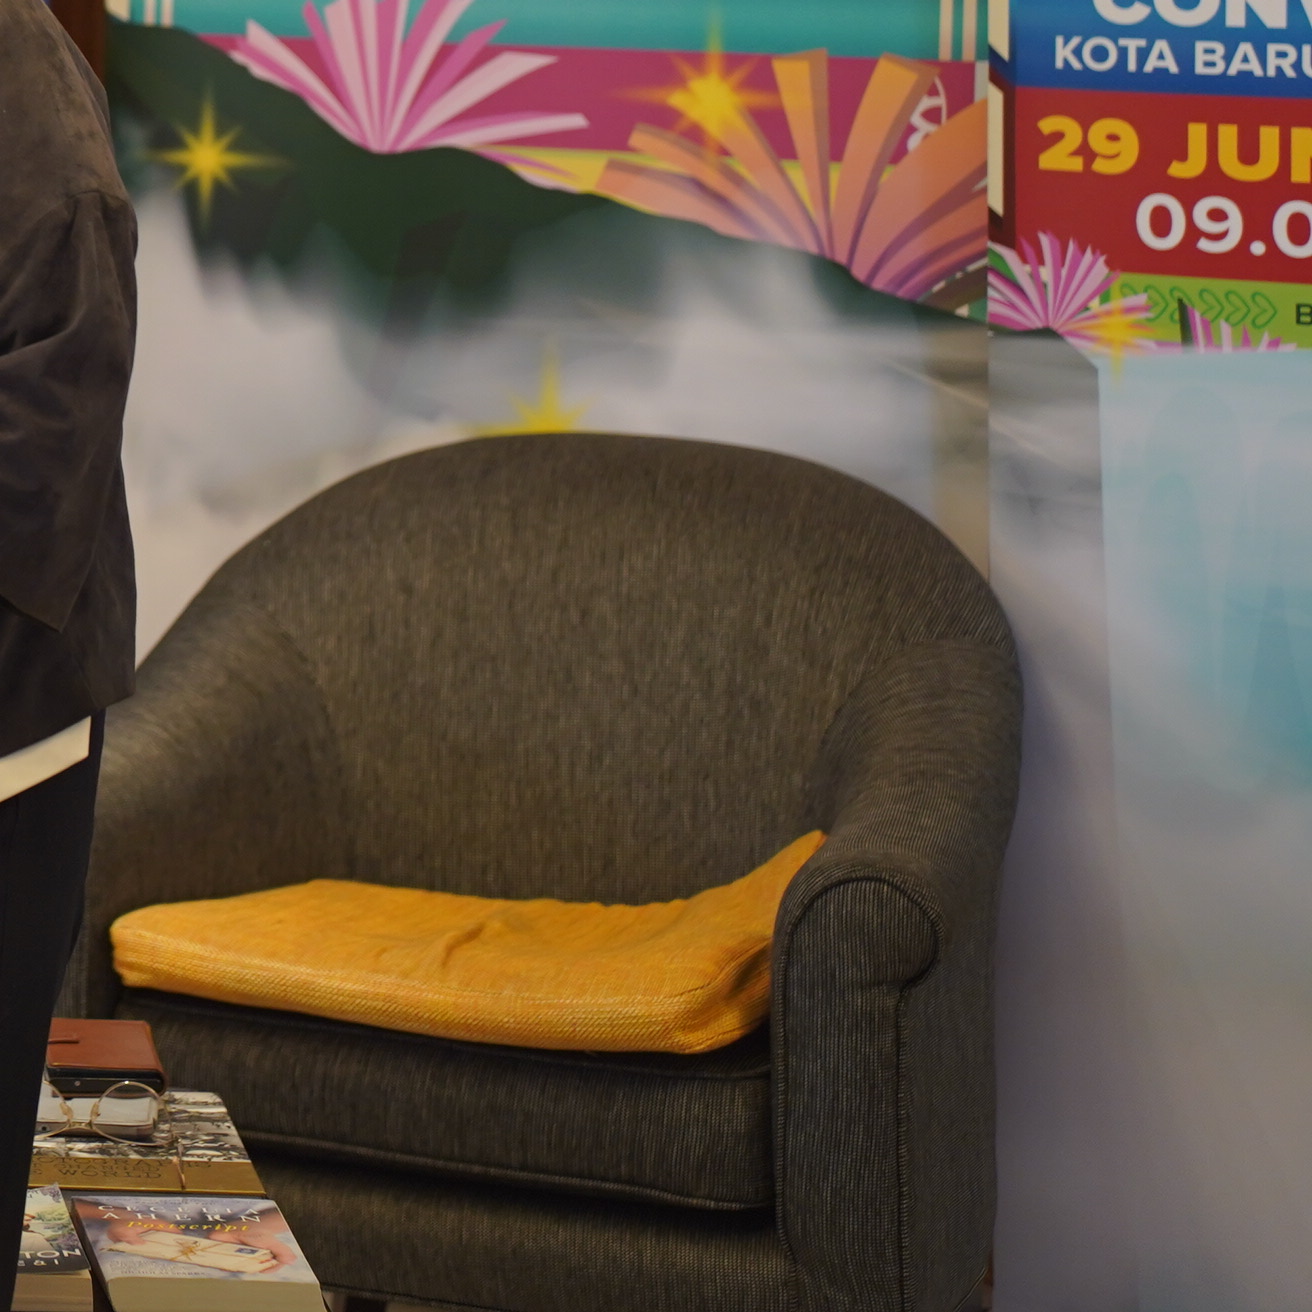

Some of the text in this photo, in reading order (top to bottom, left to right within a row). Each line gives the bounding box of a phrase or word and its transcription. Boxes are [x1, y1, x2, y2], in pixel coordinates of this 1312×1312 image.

[1054, 34, 1179, 75] KOTA
[1037, 114, 1140, 175] 29
[56, 1168, 162, 1179] WORLD
[97, 1205, 260, 1215] CECELIA
[101, 1212, 261, 1223] AHERN
[126, 1220, 250, 1232] Postscript
